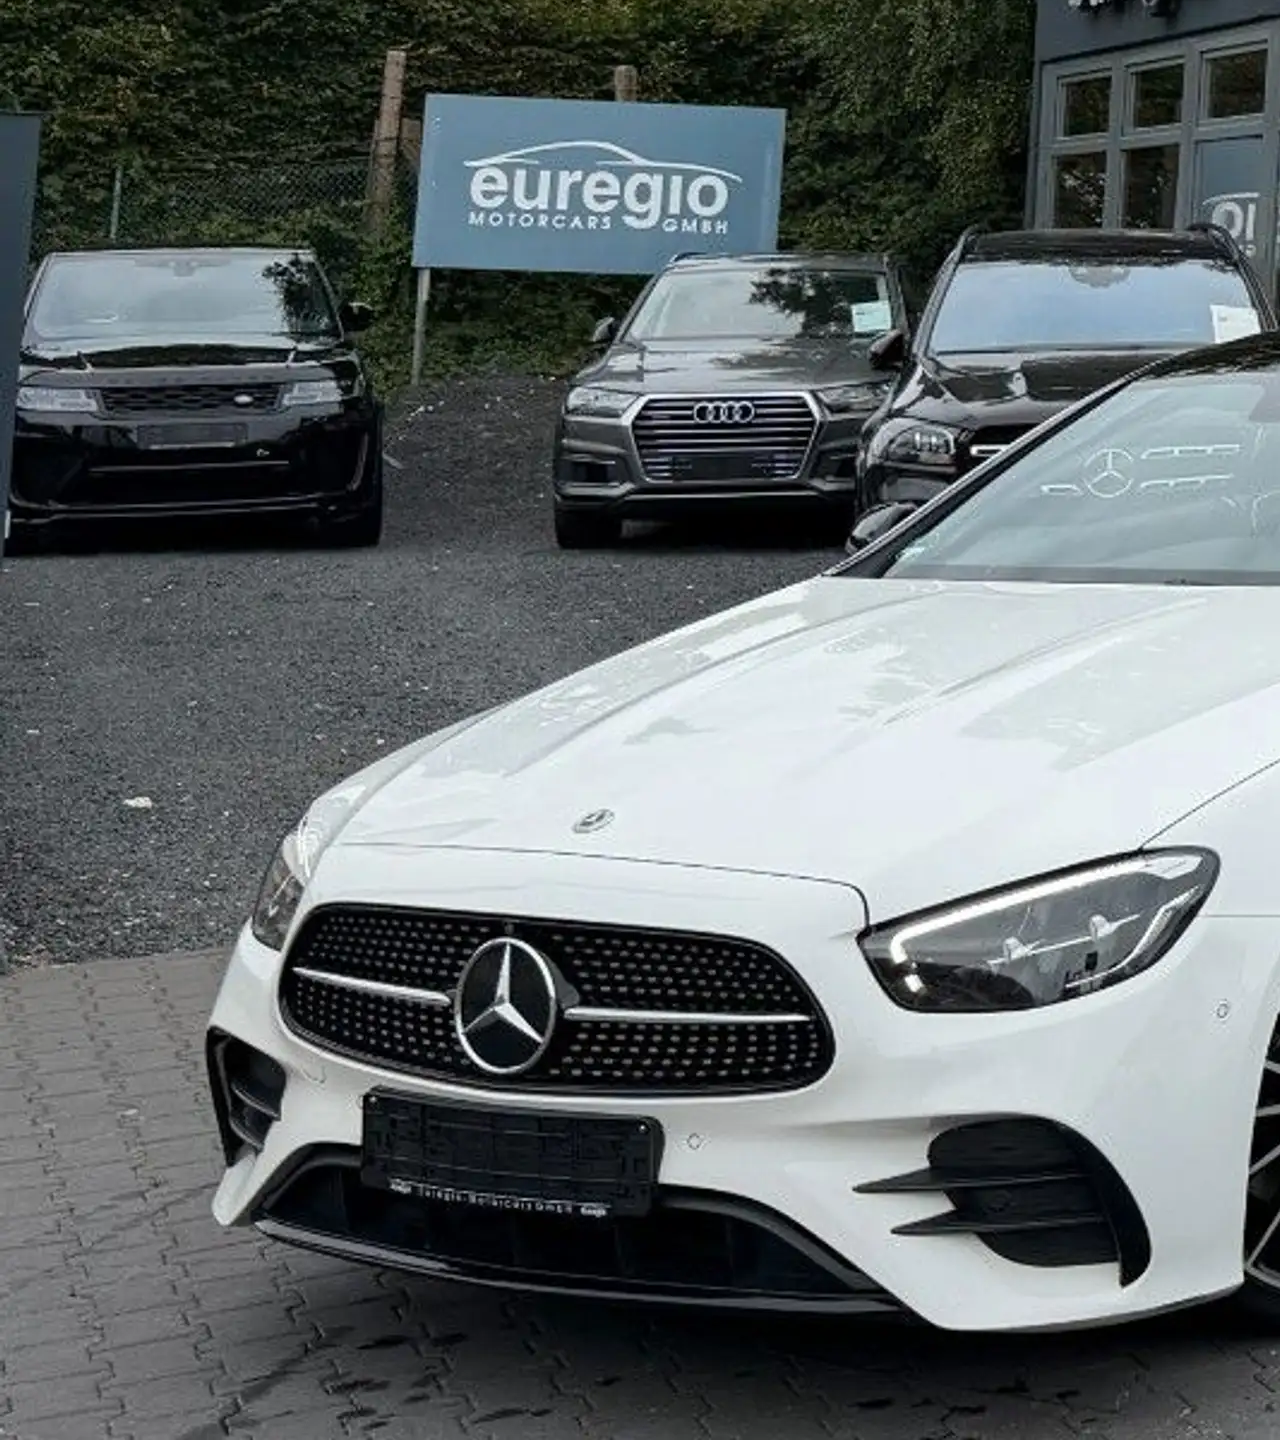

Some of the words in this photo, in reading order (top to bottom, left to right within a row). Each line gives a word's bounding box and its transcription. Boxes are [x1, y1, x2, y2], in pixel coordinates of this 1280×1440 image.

[469, 165, 729, 229] euregio
[468, 210, 612, 231] MOTORCARS
[662, 220, 729, 235] GMBH
